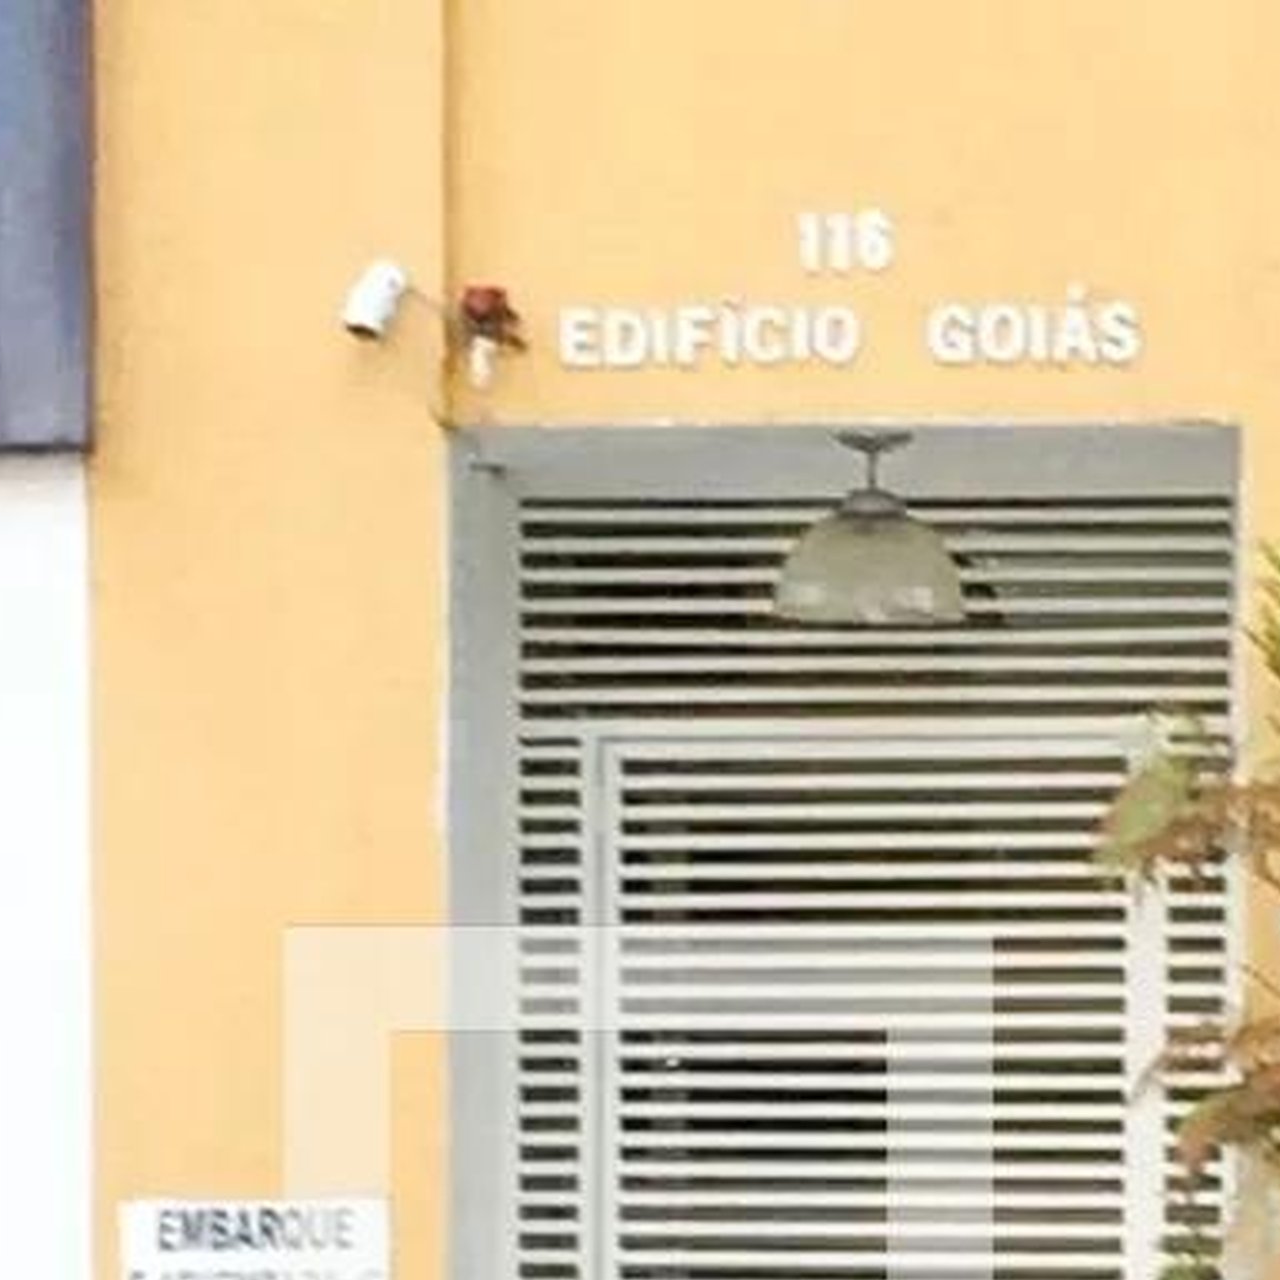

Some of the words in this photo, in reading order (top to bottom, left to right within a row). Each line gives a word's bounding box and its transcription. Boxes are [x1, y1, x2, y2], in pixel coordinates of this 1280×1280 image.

[797, 208, 894, 271] 116
[928, 282, 1141, 364] GOIÁS
[158, 1207, 356, 1250] EMBARQUE
